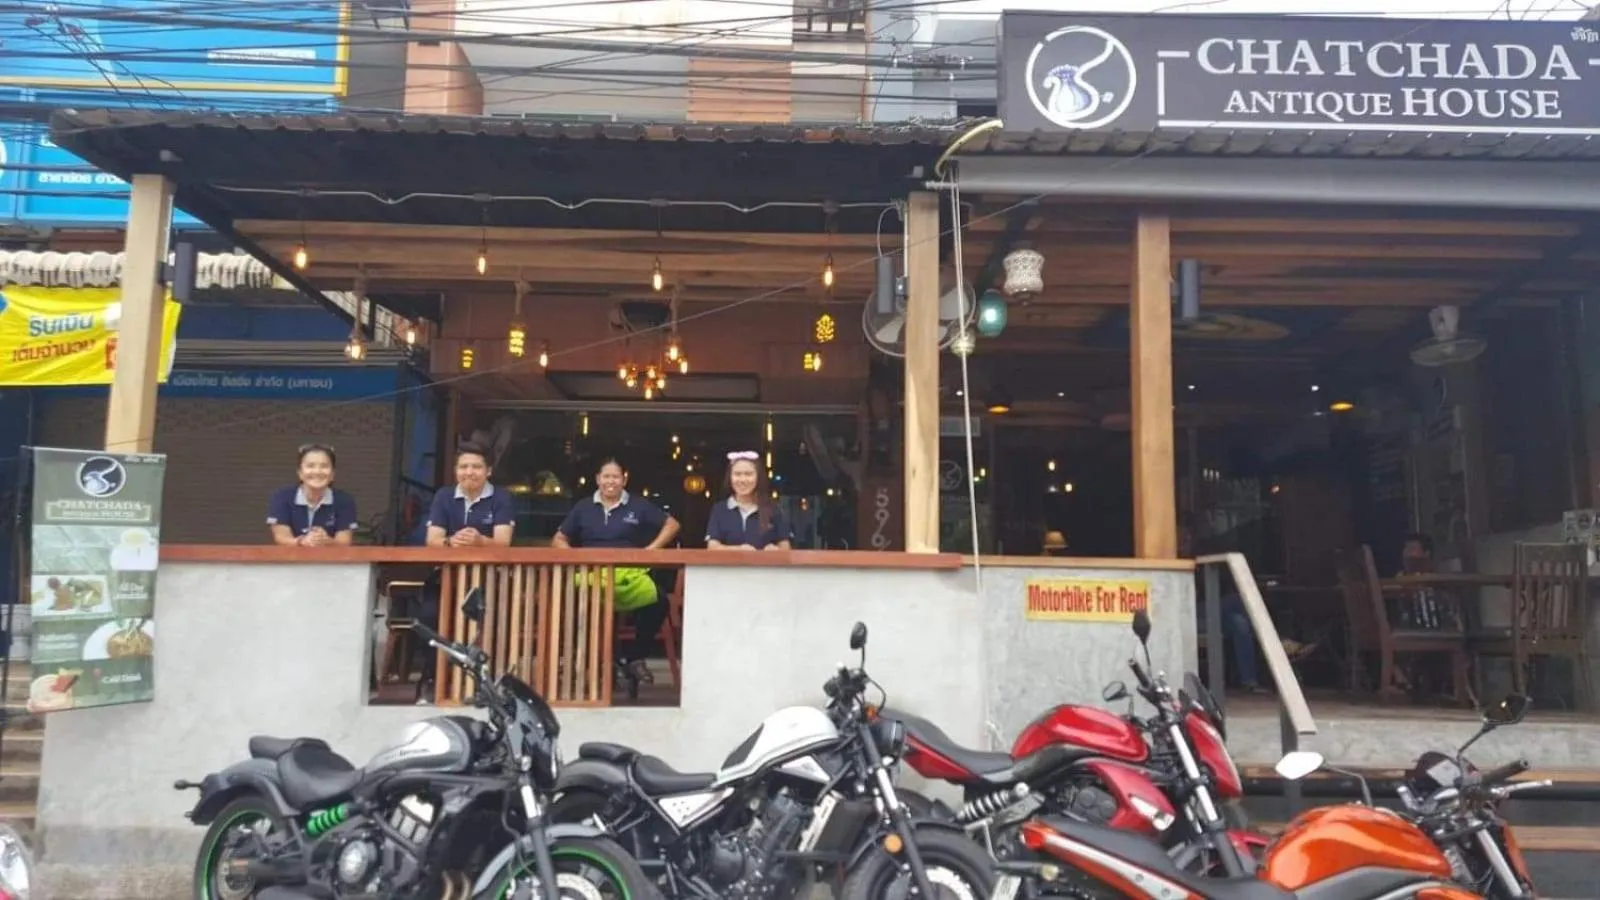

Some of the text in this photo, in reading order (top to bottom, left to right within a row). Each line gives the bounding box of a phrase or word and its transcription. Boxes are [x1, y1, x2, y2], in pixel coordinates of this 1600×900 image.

[1197, 39, 1581, 81] CHATCHADA
[1223, 88, 1562, 122] ANTIQUE HOUSE
[57, 500, 143, 512] CHATCHADA
[1028, 585, 1148, 613] Motorbike For Rent
